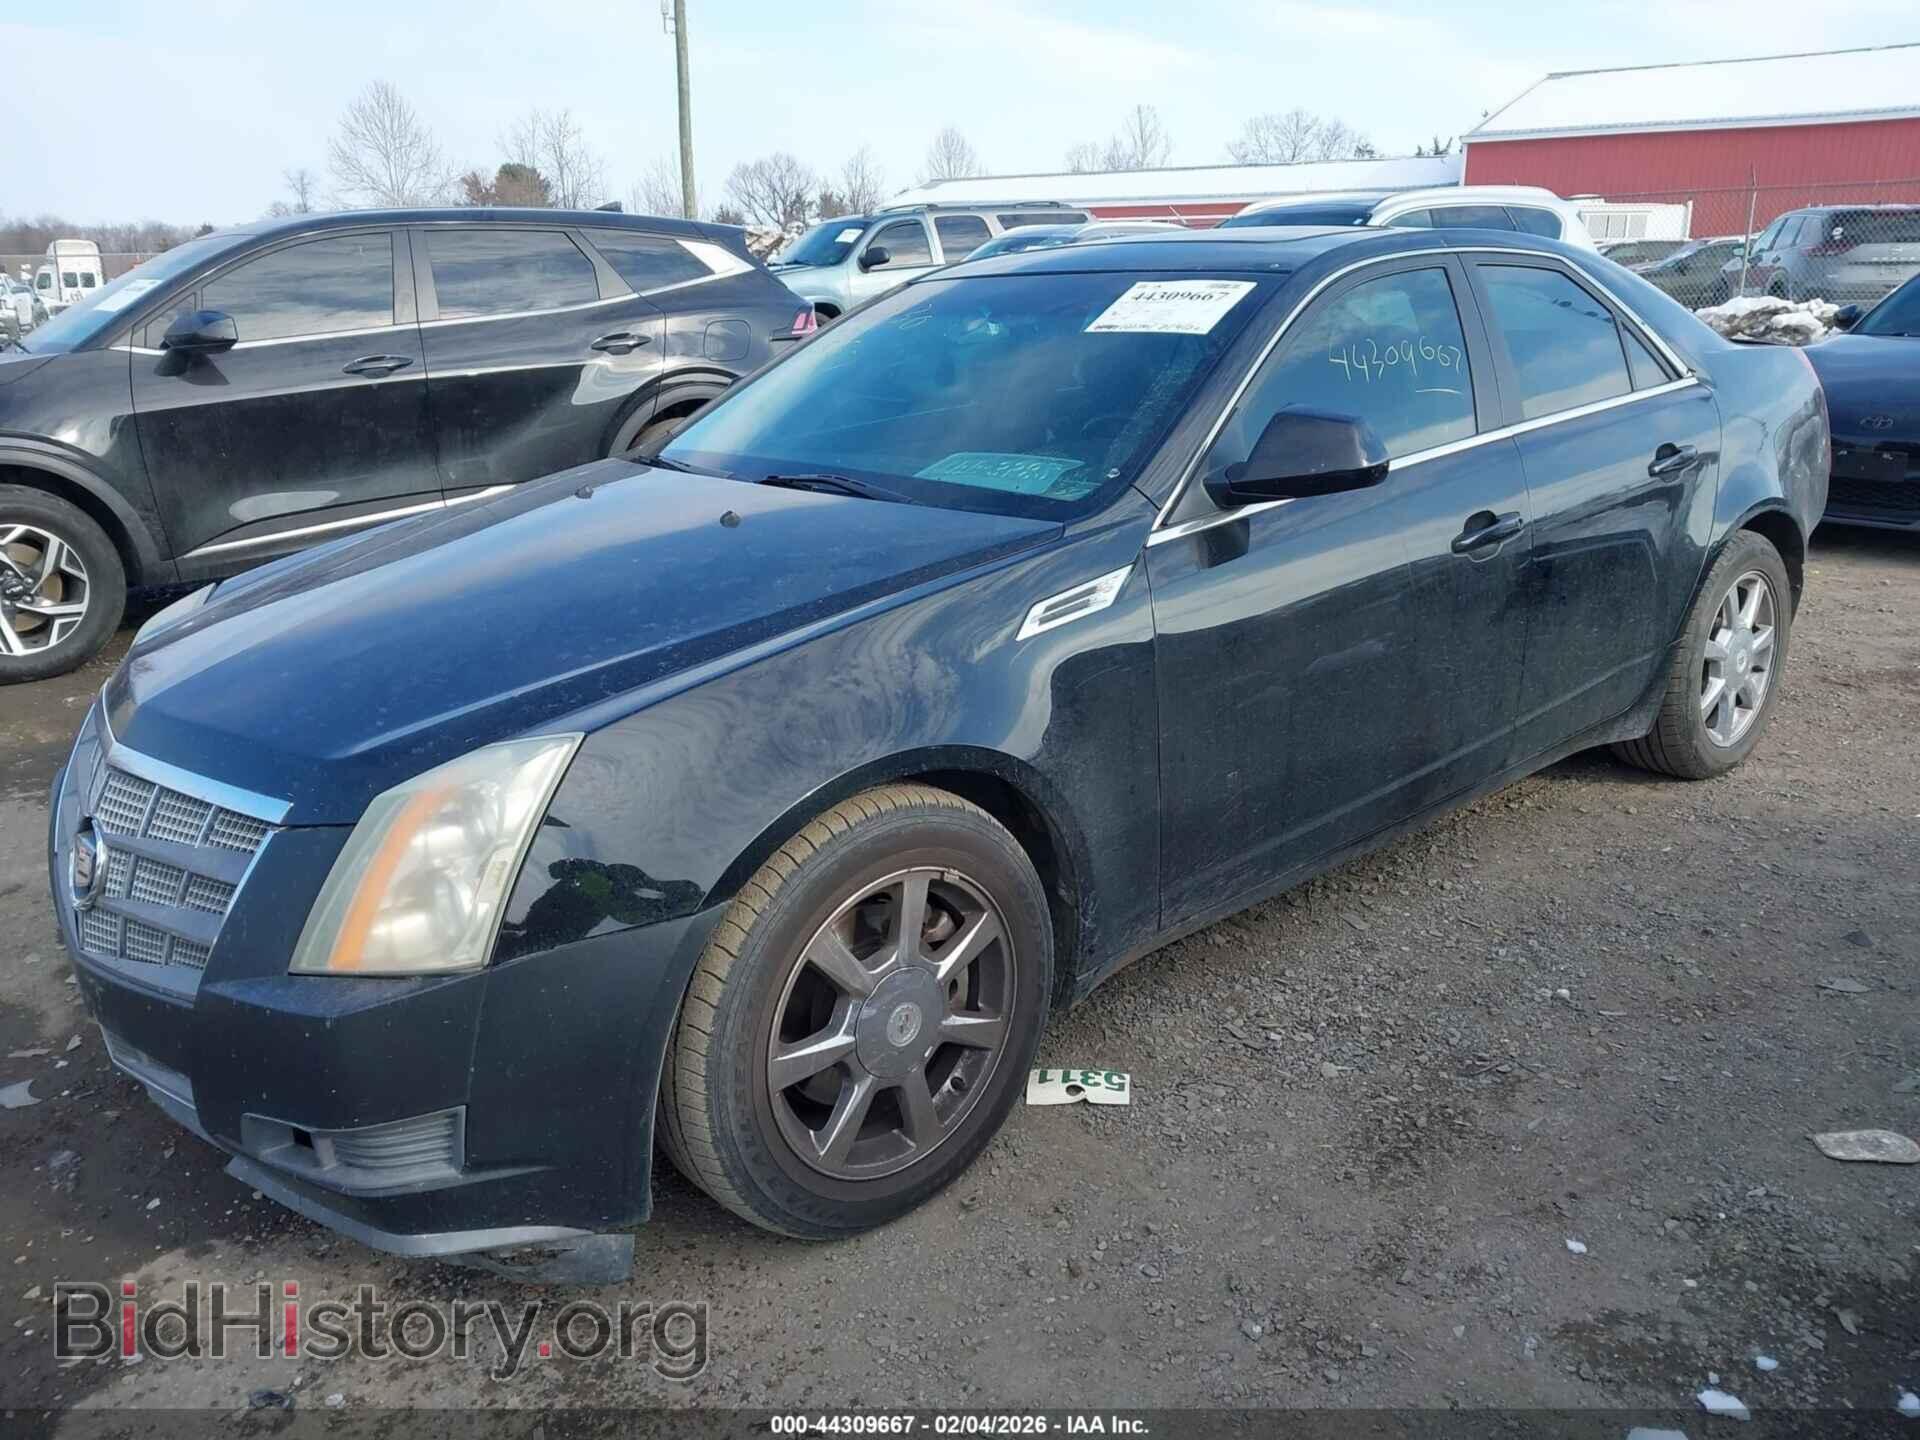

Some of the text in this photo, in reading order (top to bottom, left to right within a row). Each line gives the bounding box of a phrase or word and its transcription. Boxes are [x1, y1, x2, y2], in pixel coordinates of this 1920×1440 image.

[1131, 291, 1231, 302] 44309667
[1328, 336, 1463, 384] 44309667
[1038, 1070, 1127, 1092] 5311
